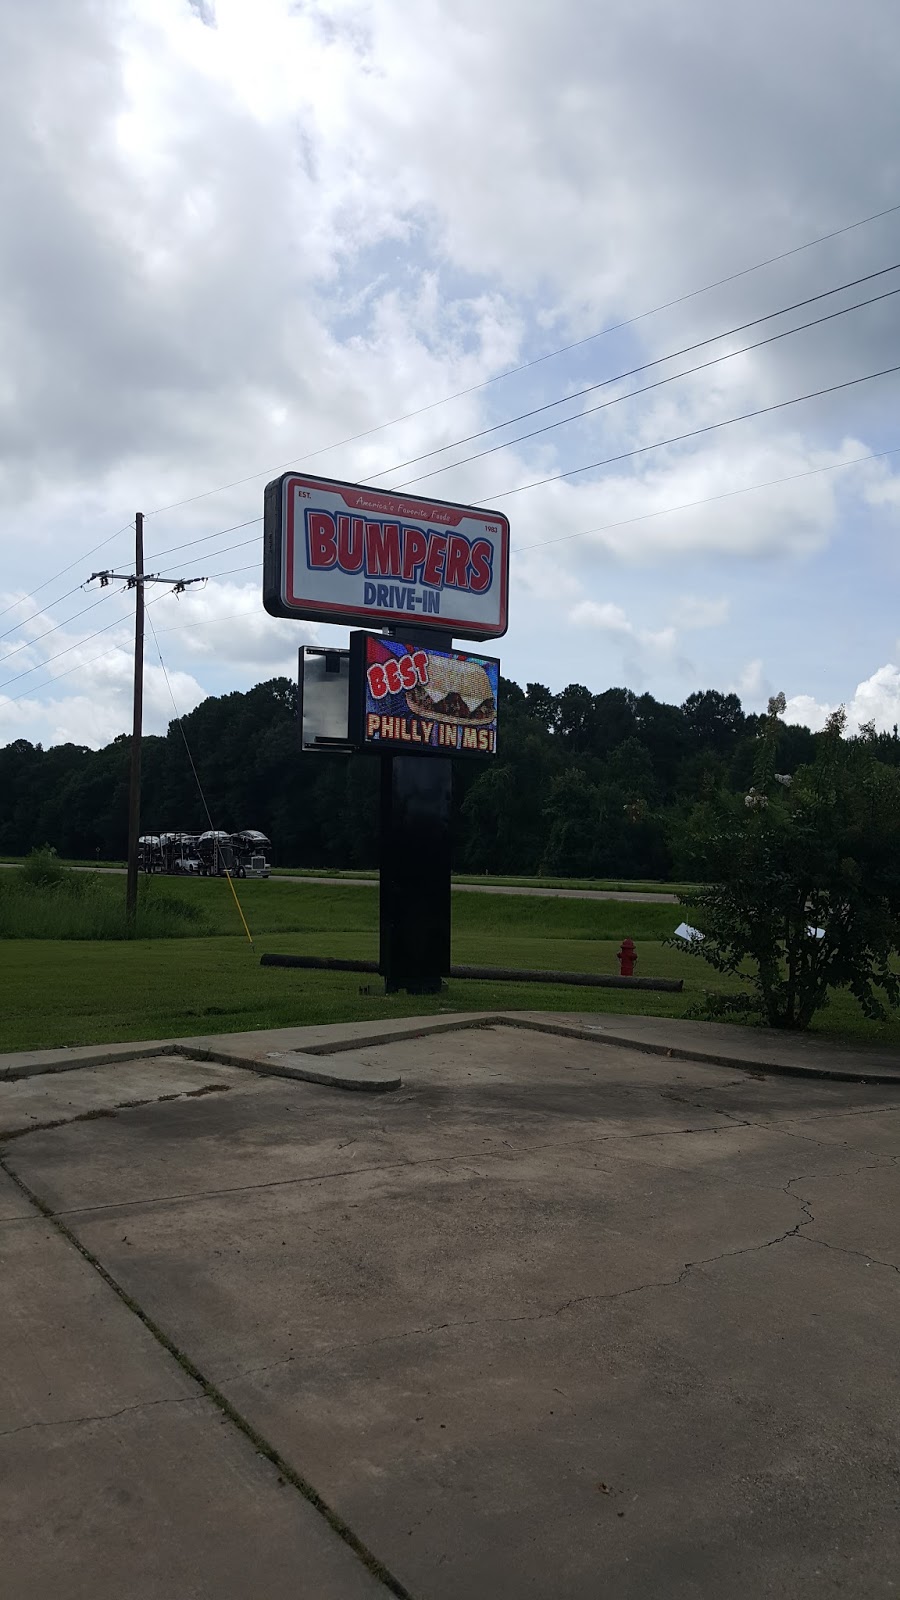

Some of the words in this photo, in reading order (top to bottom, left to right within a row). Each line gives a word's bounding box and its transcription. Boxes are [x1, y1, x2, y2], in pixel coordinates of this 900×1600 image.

[298, 491, 312, 499] EST.
[355, 496, 394, 511] America's
[397, 503, 428, 517] Favorite
[431, 510, 451, 522] Foods
[484, 525, 498, 533] 1983
[305, 509, 494, 594] BUMPERS
[363, 582, 440, 613] DRIVE-IN
[367, 651, 428, 699] BEST
[367, 714, 433, 743] PHILLY
[438, 722, 458, 746] IN
